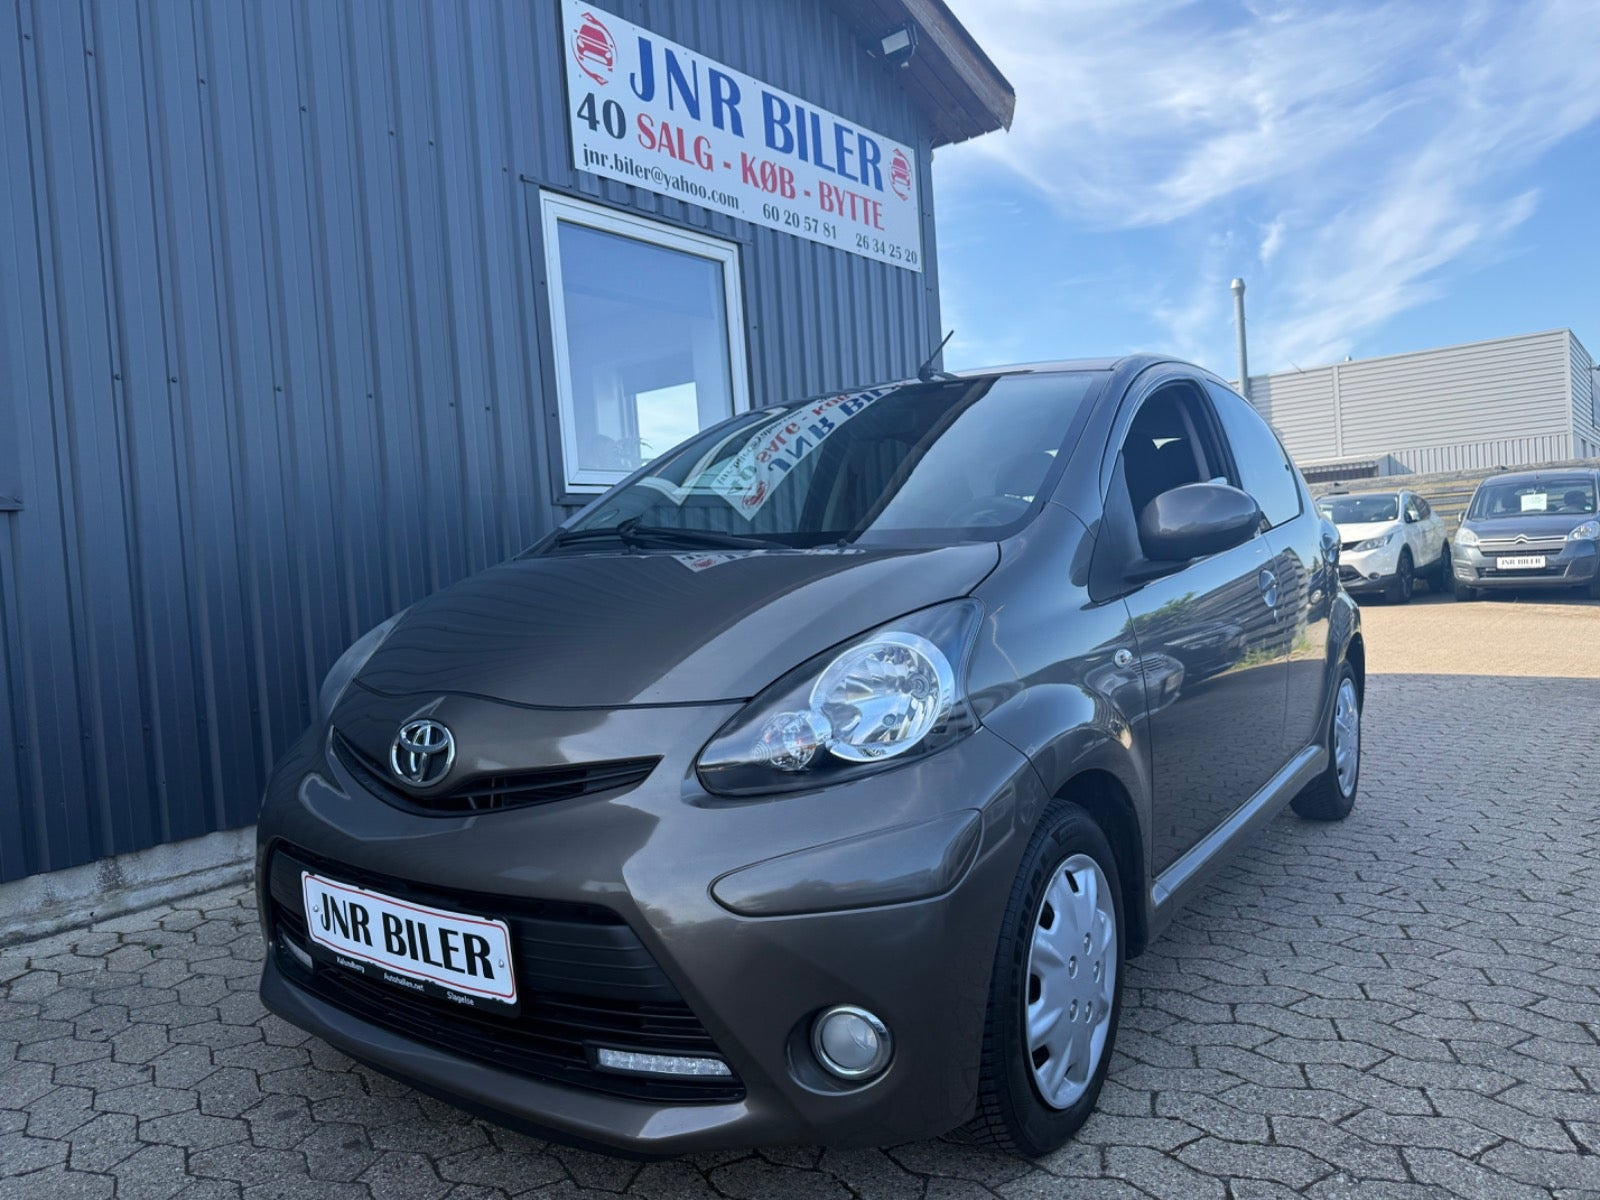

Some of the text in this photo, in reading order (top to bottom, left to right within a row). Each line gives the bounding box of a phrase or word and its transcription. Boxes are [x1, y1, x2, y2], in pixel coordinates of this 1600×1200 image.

[576, 92, 627, 140] 40
[629, 36, 885, 192] JNR BILER
[583, 143, 740, 211] jnr.biler@yahoo.com
[637, 112, 886, 232] SALG - KØB - BYTTE
[763, 203, 838, 240] 60 20 57 81
[855, 232, 918, 265] 26 34 25 20
[320, 892, 495, 980] JNR BILER
[446, 991, 475, 1006] Slagelse
